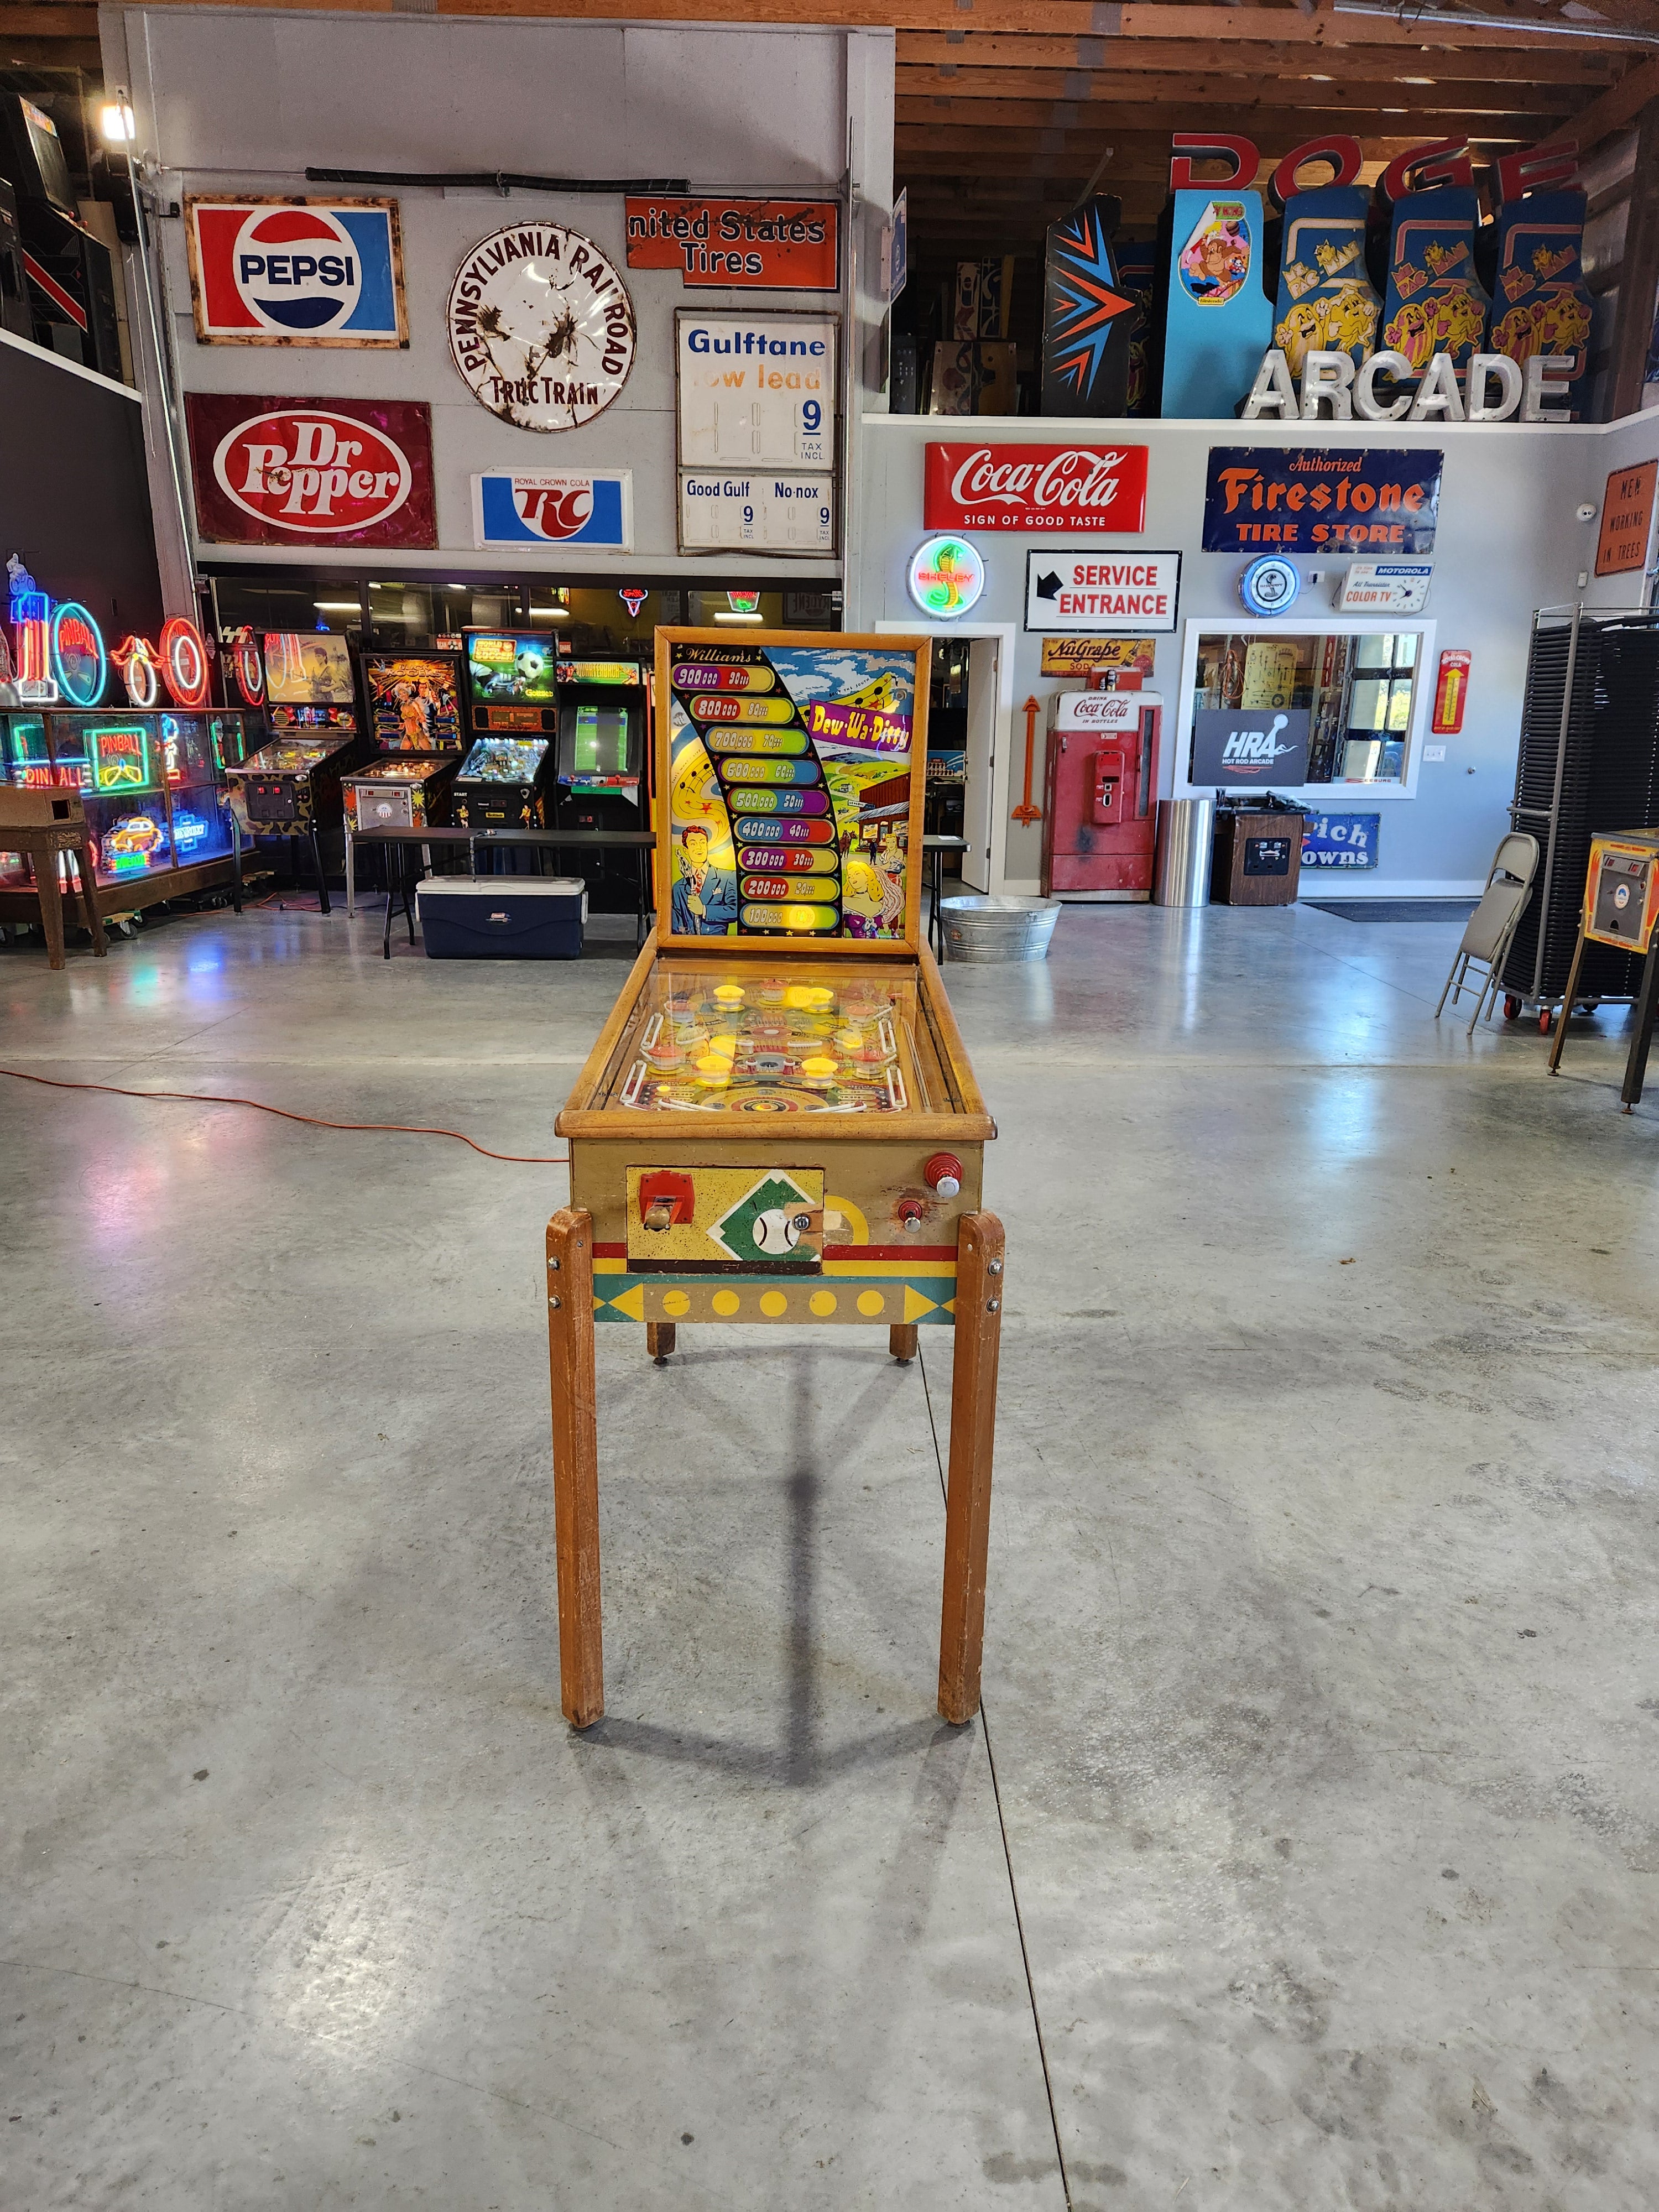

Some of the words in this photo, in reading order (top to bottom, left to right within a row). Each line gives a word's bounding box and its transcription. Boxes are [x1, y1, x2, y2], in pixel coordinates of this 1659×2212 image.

[719, 210, 825, 244] States
[680, 241, 763, 275] Tires
[240, 255, 354, 286] PEPSI
[455, 232, 560, 372] PENNSYLVANIA
[569, 244, 628, 375] RAILROAD
[688, 329, 825, 356] Gulftane
[694, 369, 745, 388] ow
[759, 364, 820, 389] lead
[1241, 349, 1574, 422] ARCADE
[802, 400, 821, 430] 9
[287, 421, 363, 467] Dr
[1289, 456, 1361, 472] Authorized
[238, 444, 399, 515] Pepper
[687, 479, 720, 497] Good
[724, 481, 750, 497] Gulf
[951, 450, 1128, 507] Coca-Cola
[1621, 476, 1641, 500] MEN
[1218, 468, 1425, 514] Firestone
[515, 488, 590, 538] RC
[743, 505, 753, 523] 9
[820, 507, 830, 524] 9
[964, 514, 995, 525] SIGN
[1002, 515, 1019, 525] OF
[1025, 516, 1064, 526] GOOD
[1070, 517, 1105, 526] TASTE
[1610, 510, 1643, 533] WORKING
[1236, 524, 1298, 541] TIRE
[1311, 524, 1405, 542] STORE
[1603, 547, 1611, 563] IN
[1619, 542, 1641, 561] TREES
[918, 572, 975, 583] SHELBY
[1073, 565, 1157, 586] SERVICE
[1060, 594, 1168, 615] ENTRANCE
[1346, 591, 1377, 602] COLOR
[1380, 591, 1392, 602] TV
[59, 618, 100, 660] PINBALL
[686, 648, 750, 662] Williams
[1048, 640, 1121, 662] NuGrape
[386, 669, 445, 678] ROGERS
[577, 663, 620, 678] QUARTERBACK
[1074, 699, 1131, 717] Coca-Cola
[100, 734, 142, 757] PINBALL
[1223, 726, 1277, 758] HRA
